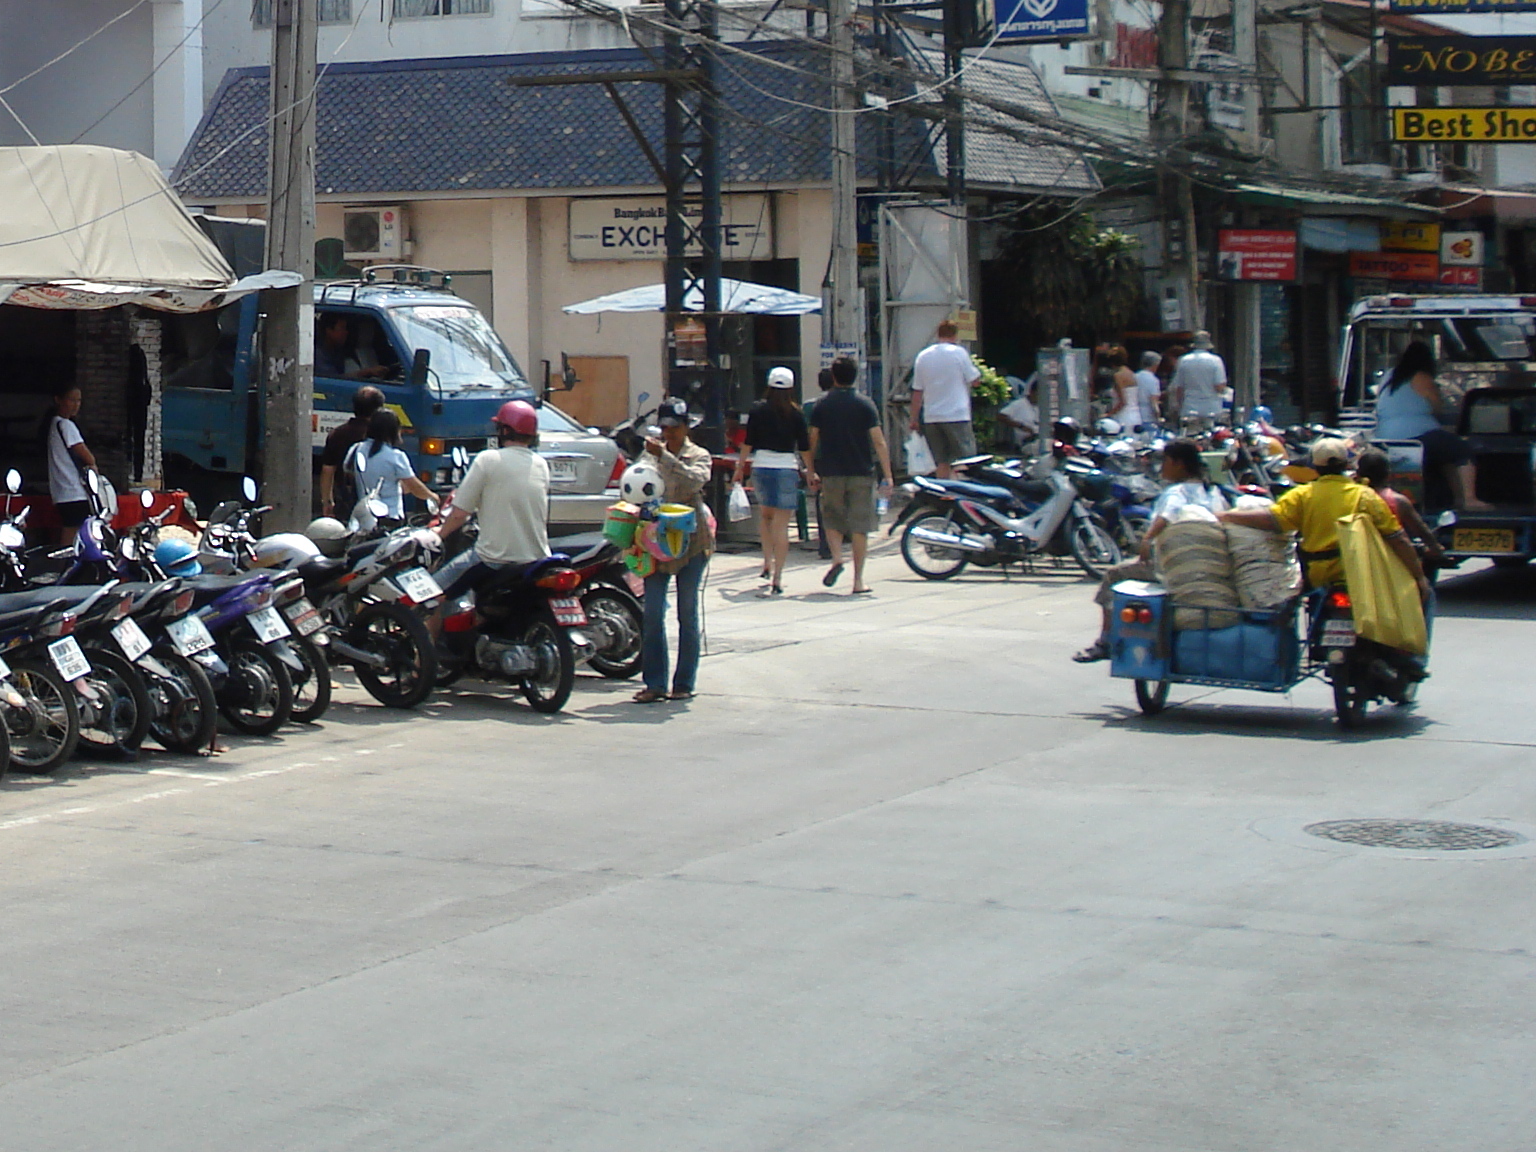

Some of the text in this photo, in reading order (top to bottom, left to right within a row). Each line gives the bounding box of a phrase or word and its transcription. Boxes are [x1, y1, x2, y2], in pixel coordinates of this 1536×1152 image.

[1404, 112, 1473, 138] Best
[614, 207, 657, 221] Bangkok
[602, 225, 740, 247] EXCHE
